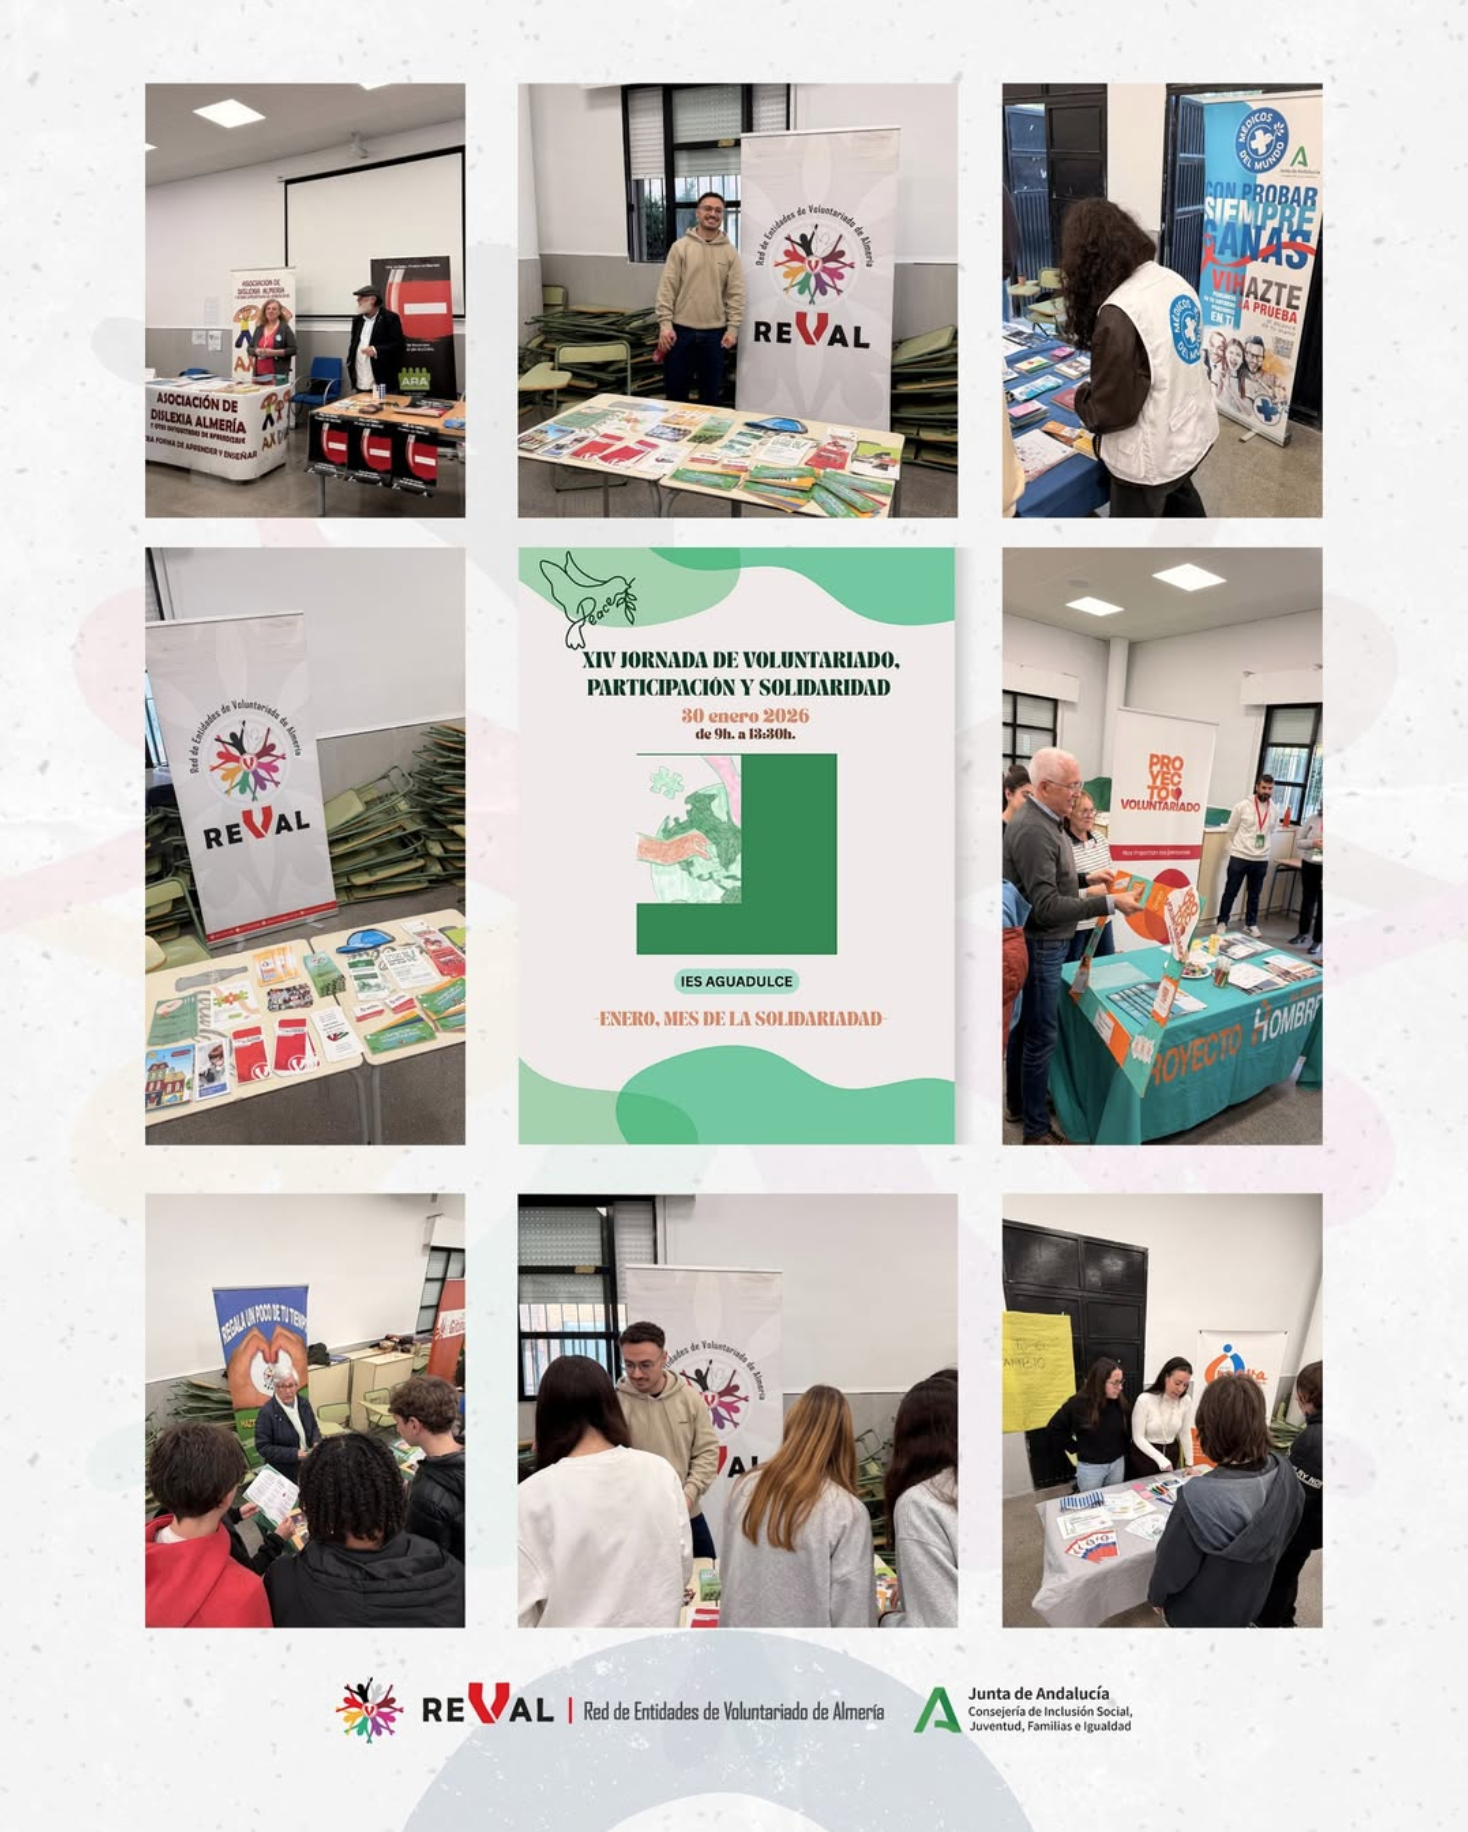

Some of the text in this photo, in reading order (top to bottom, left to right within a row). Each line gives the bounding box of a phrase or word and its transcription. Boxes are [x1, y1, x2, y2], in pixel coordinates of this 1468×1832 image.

[1238, 112, 1274, 143] MÉDICOS
[1239, 141, 1285, 171] DEL MUNDO
[1206, 181, 1318, 207] CON PROBAR
[796, 206, 806, 216] de
[808, 204, 856, 228] Voluntariado
[1204, 196, 1317, 234] SIEMPRE
[763, 212, 796, 240] Entidades
[854, 226, 864, 237] de
[760, 240, 769, 250] de
[1204, 218, 1312, 270] GANAS
[755, 251, 765, 266] Red
[1238, 299, 1250, 312] LA
[1253, 301, 1298, 324] PRUEBA
[754, 311, 870, 349] REVAL
[401, 376, 428, 387] ARA
[156, 391, 238, 413] ASOCIACIÓN DE
[150, 408, 247, 434] DISLEXIA ALMERÍA
[155, 436, 176, 448] FORMA
[177, 440, 184, 449] DE
[185, 442, 218, 456] APRENDER
[224, 449, 258, 461] ENSEÑAR
[577, 597, 614, 625] Peace
[583, 651, 900, 670] XIV JORNADA DE VOLUNTARIADO,
[587, 676, 891, 696] PARTICIPACIÓN Y SOLIDARIDAD
[221, 704, 231, 714] de
[231, 699, 281, 719] Voluntariado
[681, 707, 810, 724] 30 enero 2026
[191, 710, 221, 744] Entidades
[279, 716, 289, 727] de
[695, 728, 796, 740] de 9h. a 13:30h.
[189, 745, 200, 756] de
[189, 757, 199, 774] Red
[1148, 753, 1184, 772] PRO
[1149, 770, 1182, 787] YEC
[1147, 785, 1170, 801] TO
[1120, 798, 1200, 813] VOLUNTARIADO
[203, 804, 310, 849] REVAL
[681, 975, 793, 988] IES AGUADULCE
[664, 1010, 699, 1026] MES
[703, 1010, 726, 1026] DE
[729, 1010, 751, 1026] LA
[1152, 1023, 1243, 1087] ROYECTO
[221, 1303, 307, 1346] REGALA UN POCO DE TU TIEMP
[690, 1342, 700, 1352] de
[701, 1340, 749, 1363] Voluntariado
[746, 1361, 756, 1372] de
[1003, 1357, 1046, 1370] AMBIO
